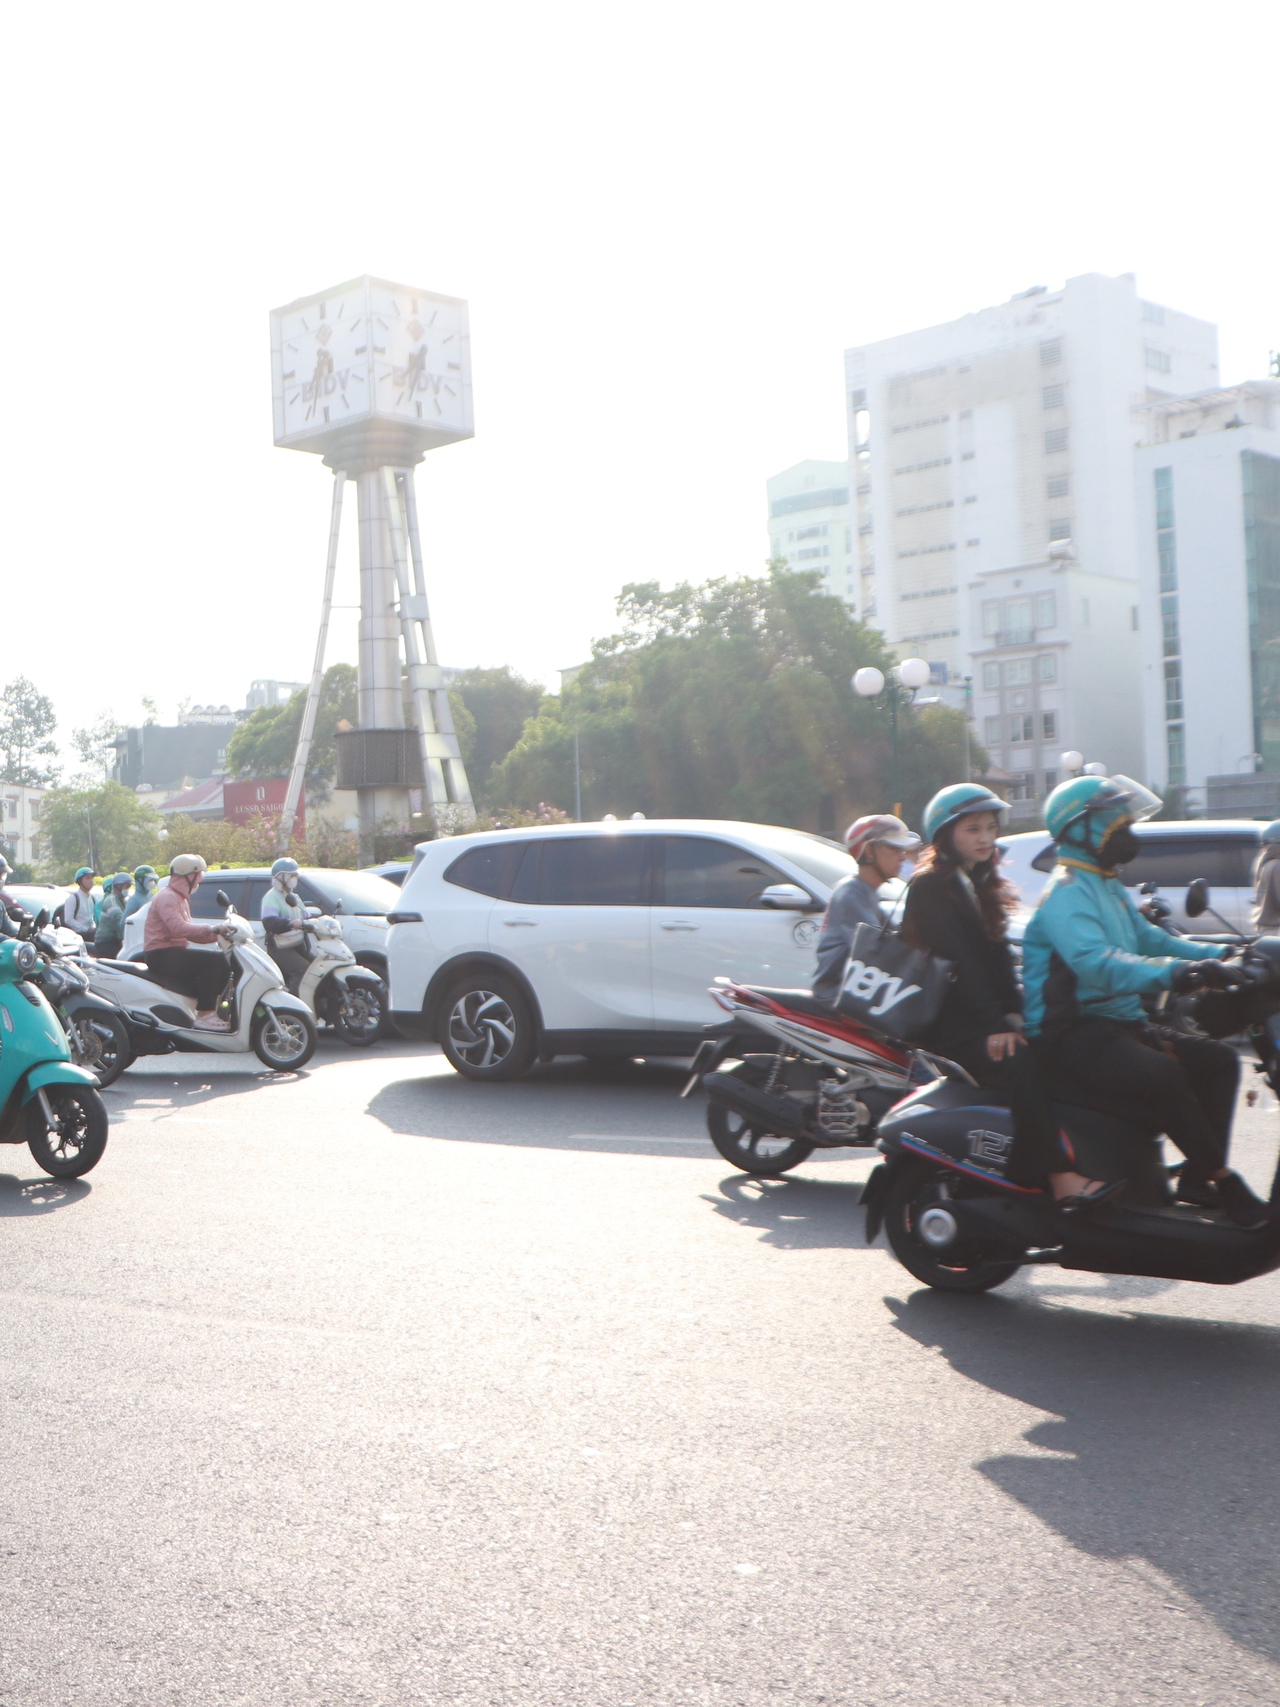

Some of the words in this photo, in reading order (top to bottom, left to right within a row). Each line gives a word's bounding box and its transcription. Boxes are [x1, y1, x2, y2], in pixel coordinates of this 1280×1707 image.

[302, 368, 351, 402] BIDV
[393, 367, 443, 395] BIDV
[235, 804, 259, 814] LUSSO
[261, 803, 286, 812] SAIGO
